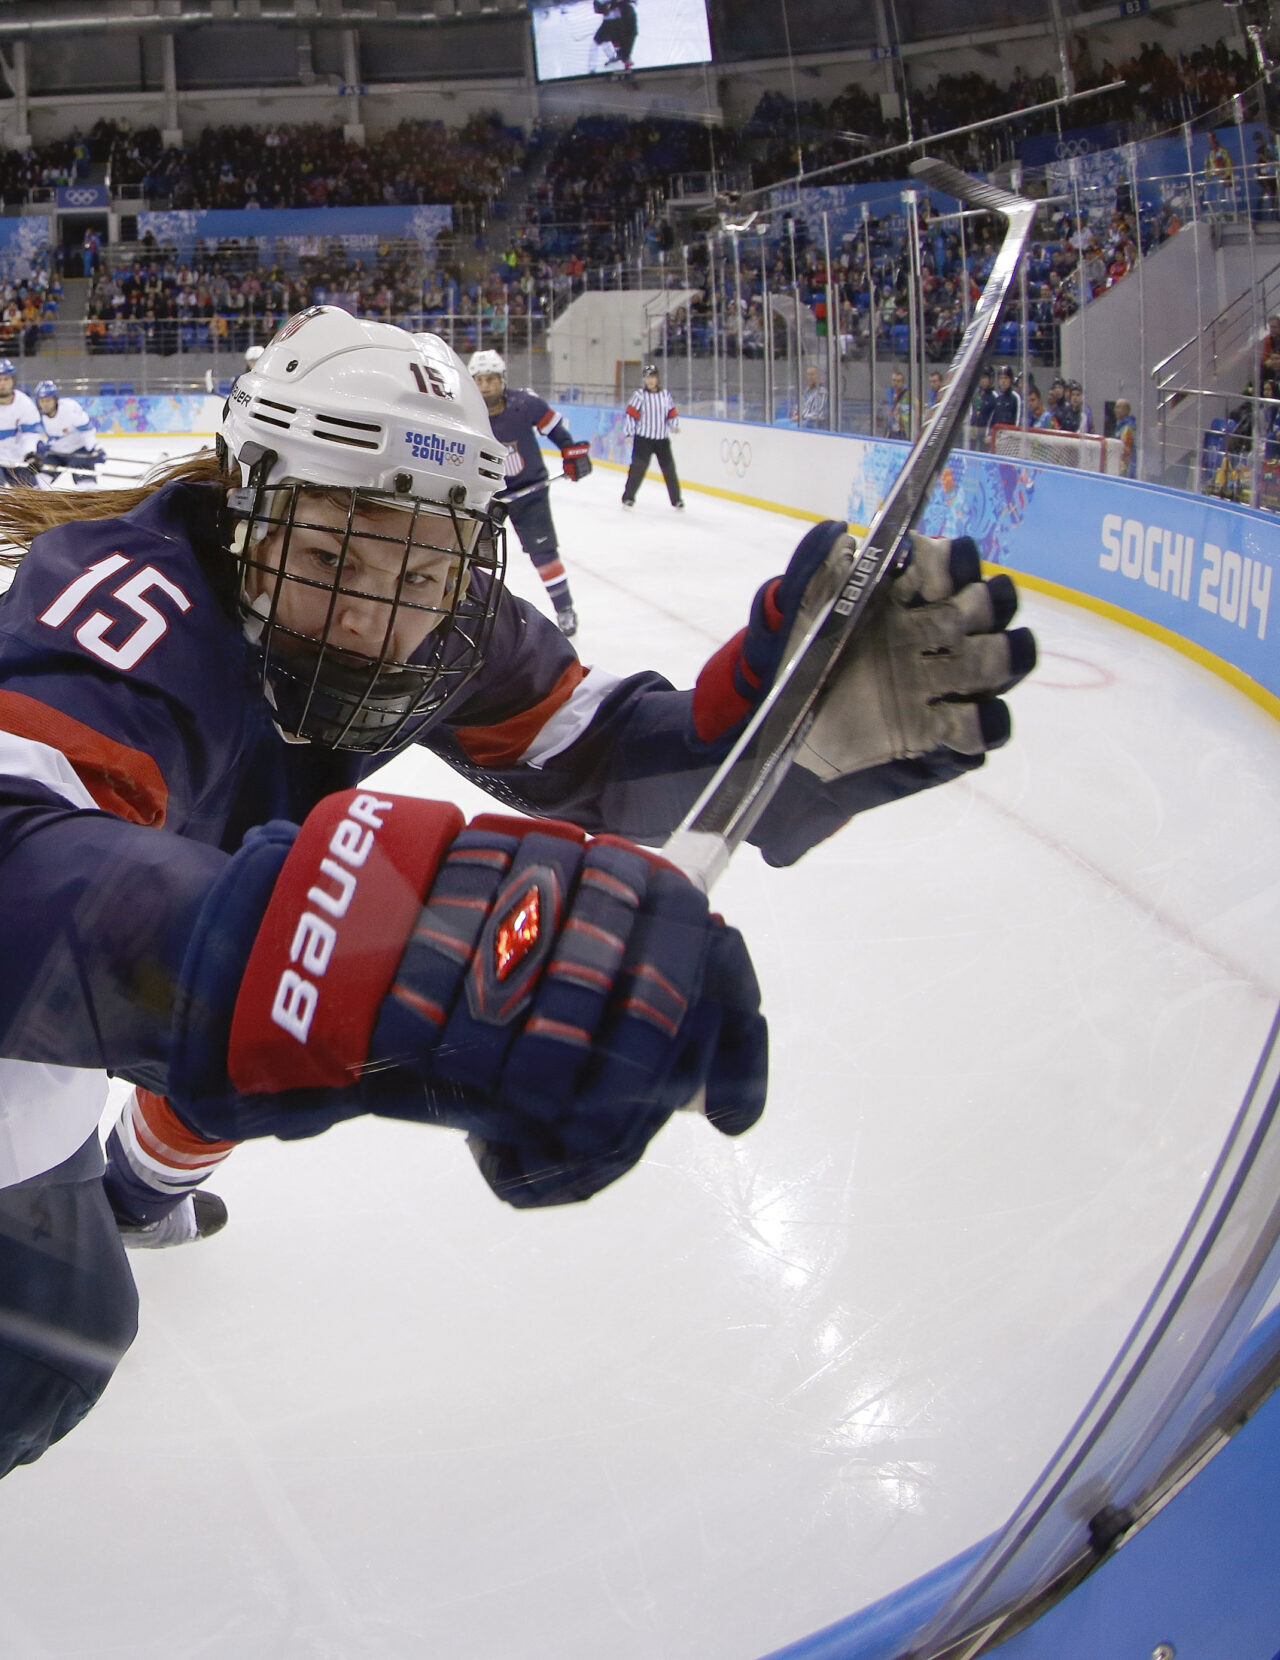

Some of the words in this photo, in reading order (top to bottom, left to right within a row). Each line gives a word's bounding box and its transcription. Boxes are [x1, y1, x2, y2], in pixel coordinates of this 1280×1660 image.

[409, 362, 446, 398] 15
[405, 431, 465, 456] sochi.ru
[411, 445, 444, 466] 2014
[1099, 513, 1194, 602] SOCHI
[1198, 542, 1272, 641] 2014
[36, 551, 195, 672] 15
